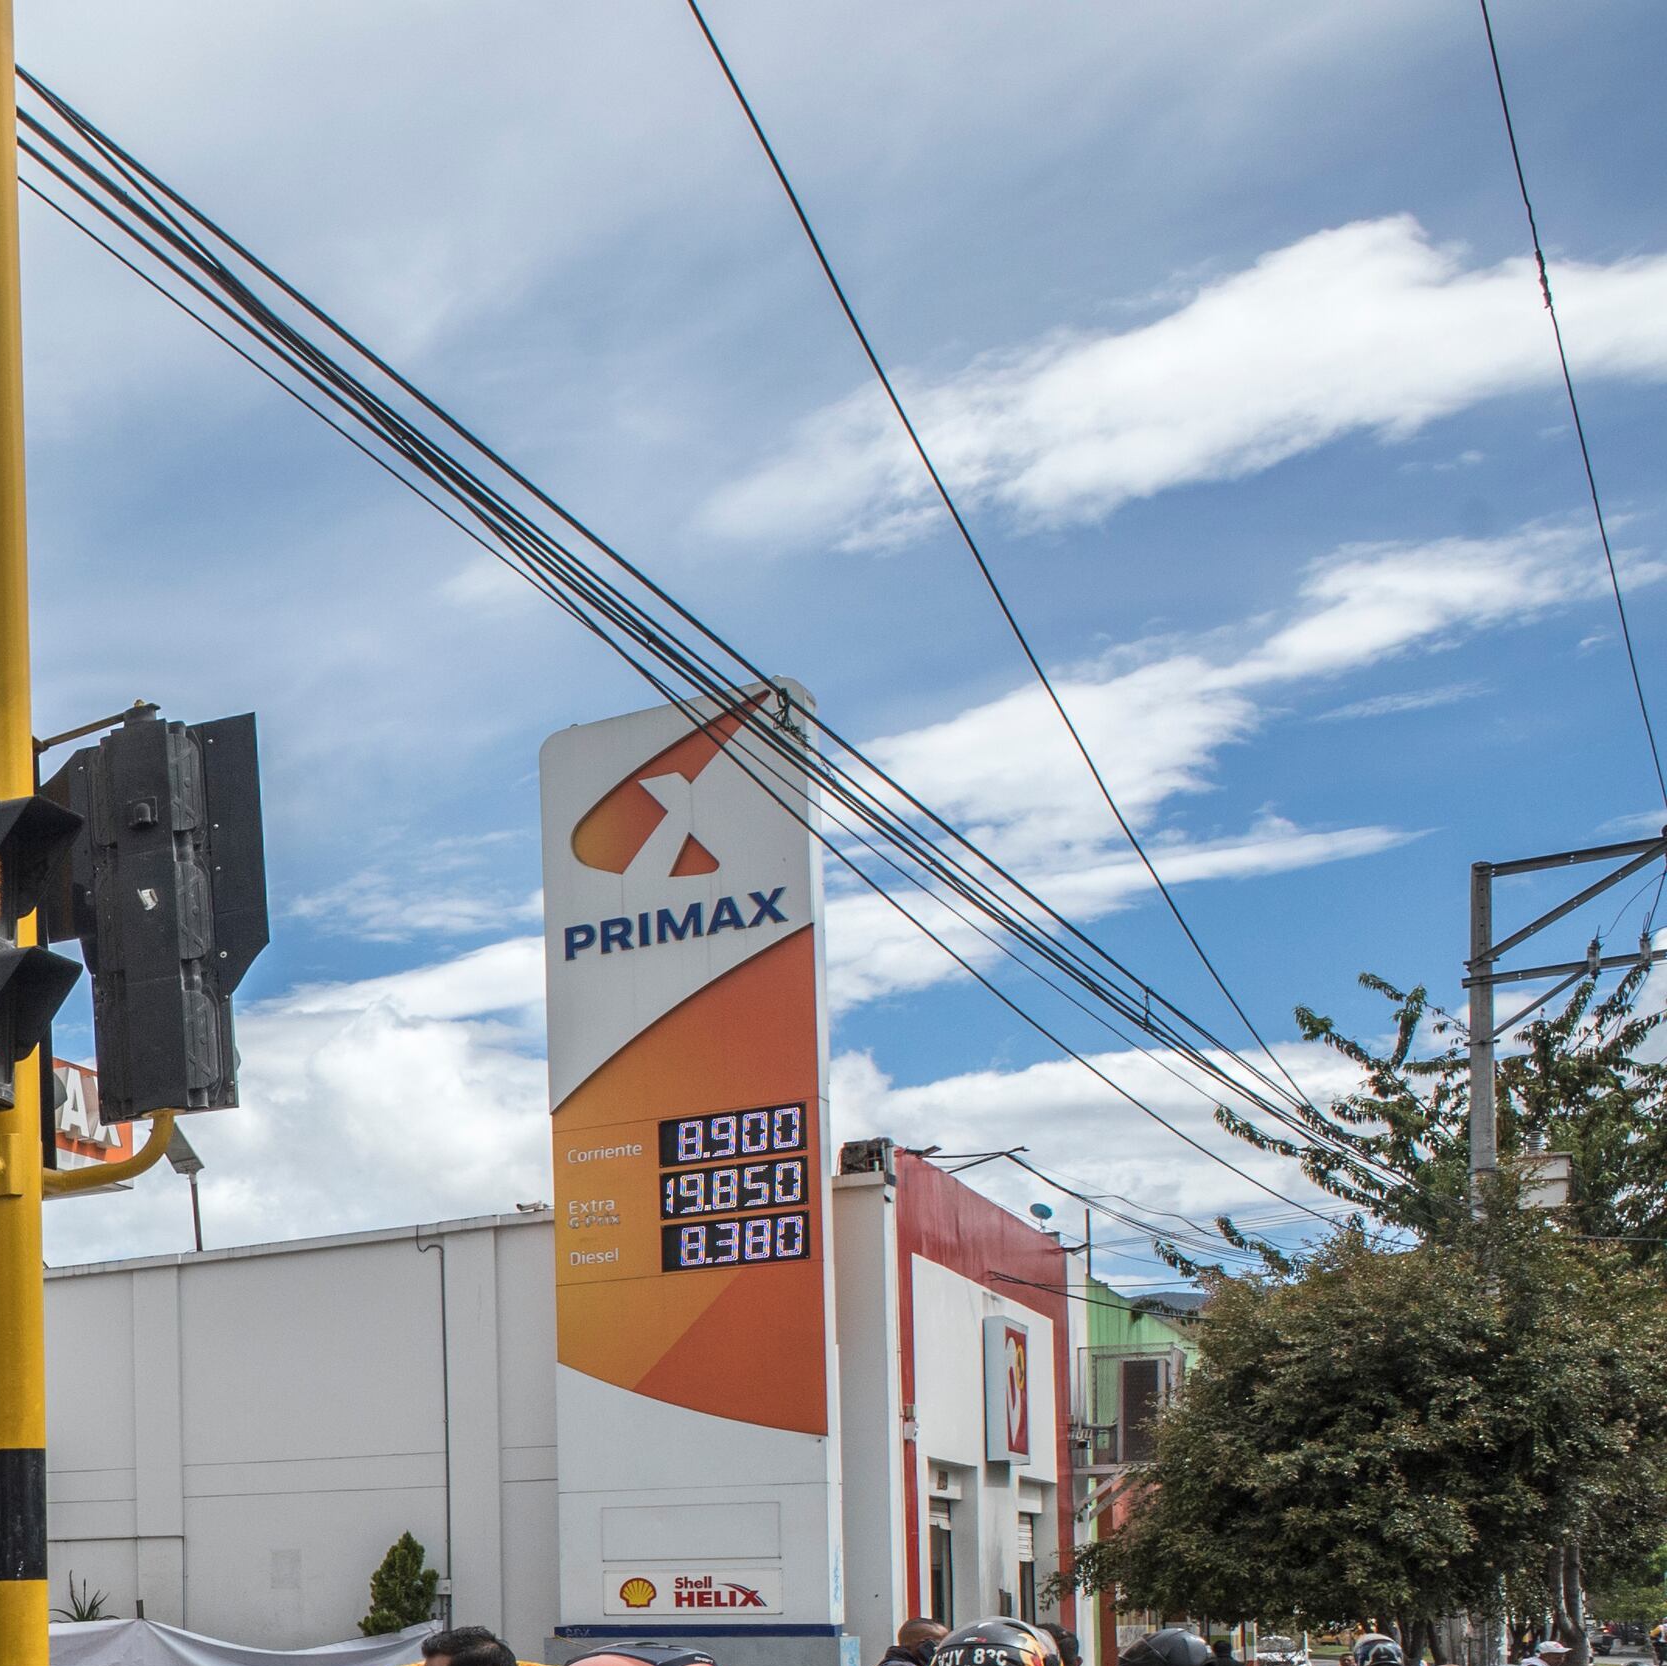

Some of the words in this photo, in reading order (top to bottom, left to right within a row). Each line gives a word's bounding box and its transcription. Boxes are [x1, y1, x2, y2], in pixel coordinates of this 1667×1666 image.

[565, 886, 788, 961] PRIMAX
[568, 1142, 642, 1163] Corriente
[678, 1107, 800, 1161] 8.900
[569, 1199, 614, 1215] Extra
[570, 1249, 619, 1266] Diesel
[681, 1216, 802, 1266] 8.380
[674, 1586, 767, 1607] HELIX
[675, 1576, 712, 1588] Shell
